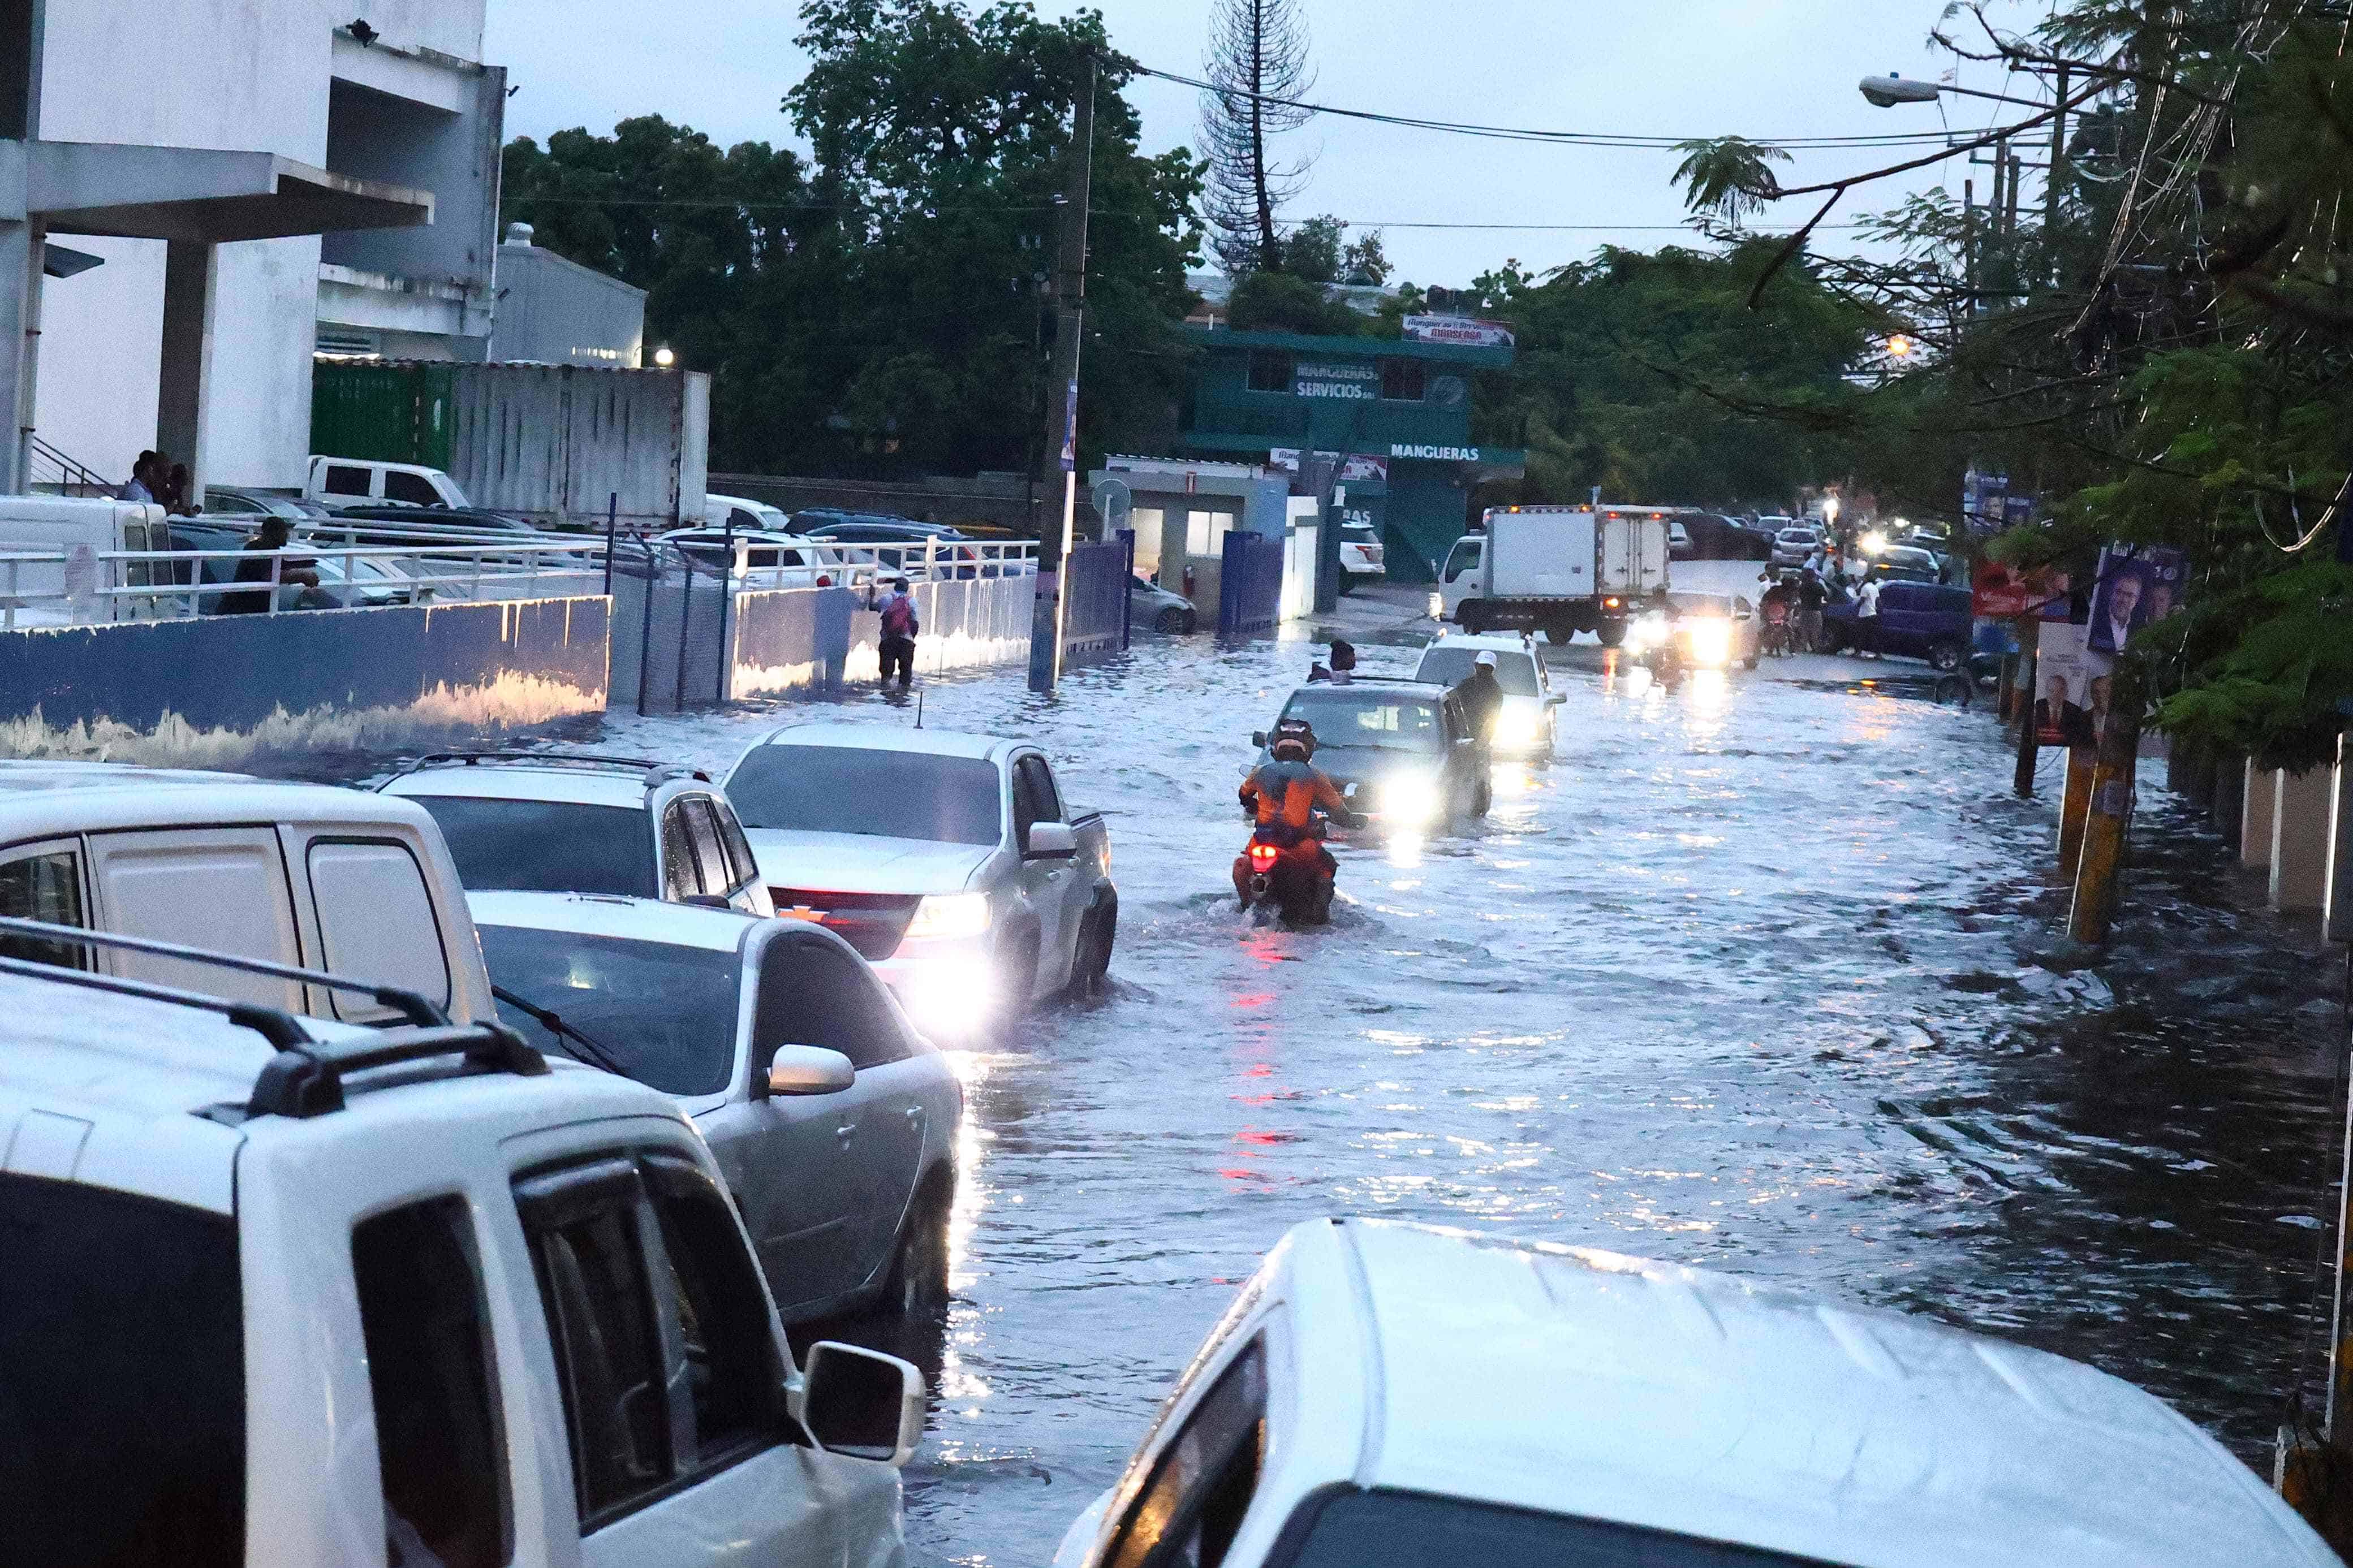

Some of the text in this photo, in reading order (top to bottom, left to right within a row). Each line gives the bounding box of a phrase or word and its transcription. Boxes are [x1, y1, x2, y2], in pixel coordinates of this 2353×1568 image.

[1296, 381, 1362, 399] SERVICIOS
[1391, 444, 1479, 461] MANGUERAS
[1342, 509, 1371, 524] RAS
